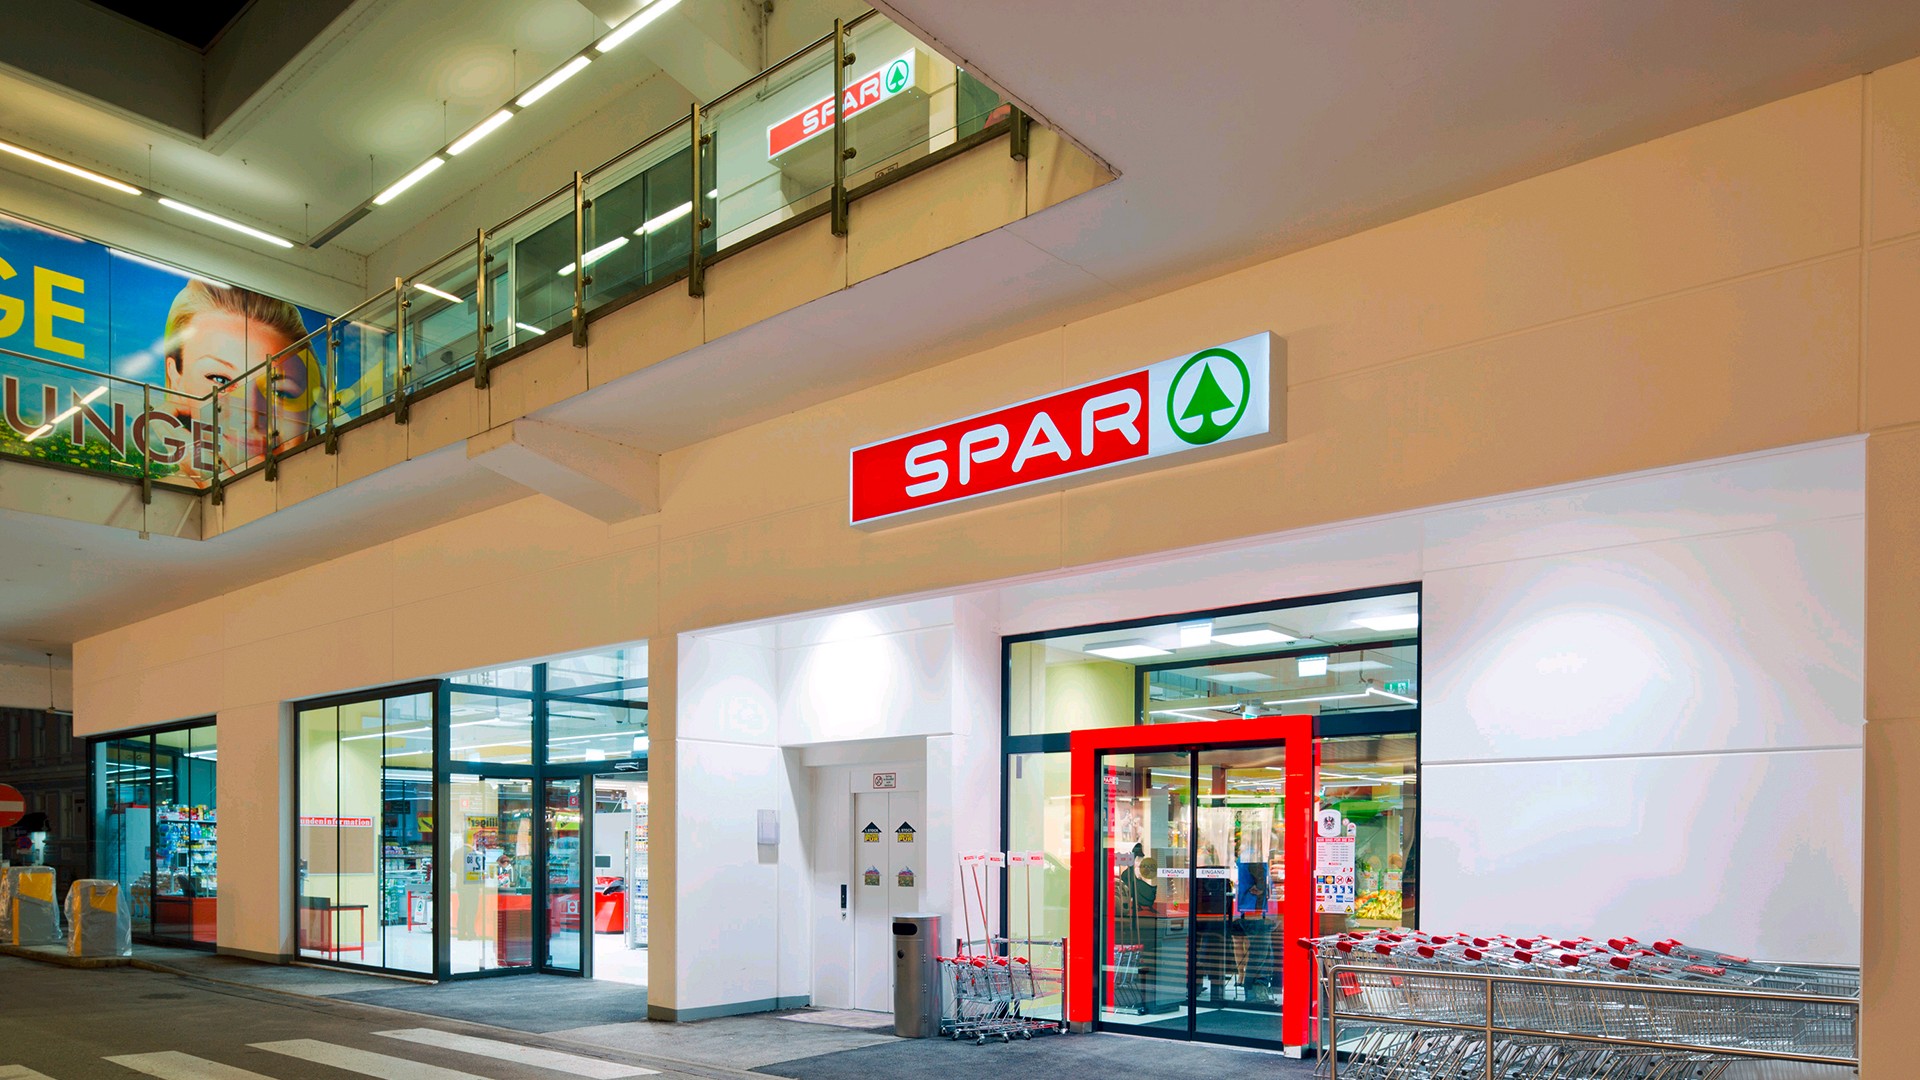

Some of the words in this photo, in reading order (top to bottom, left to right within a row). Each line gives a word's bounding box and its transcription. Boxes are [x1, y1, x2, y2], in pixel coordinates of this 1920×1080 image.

[802, 77, 880, 135] SPAR
[2, 374, 224, 474] UNGE
[904, 387, 1142, 498] SPAR
[300, 816, 370, 826] undeninfrmation
